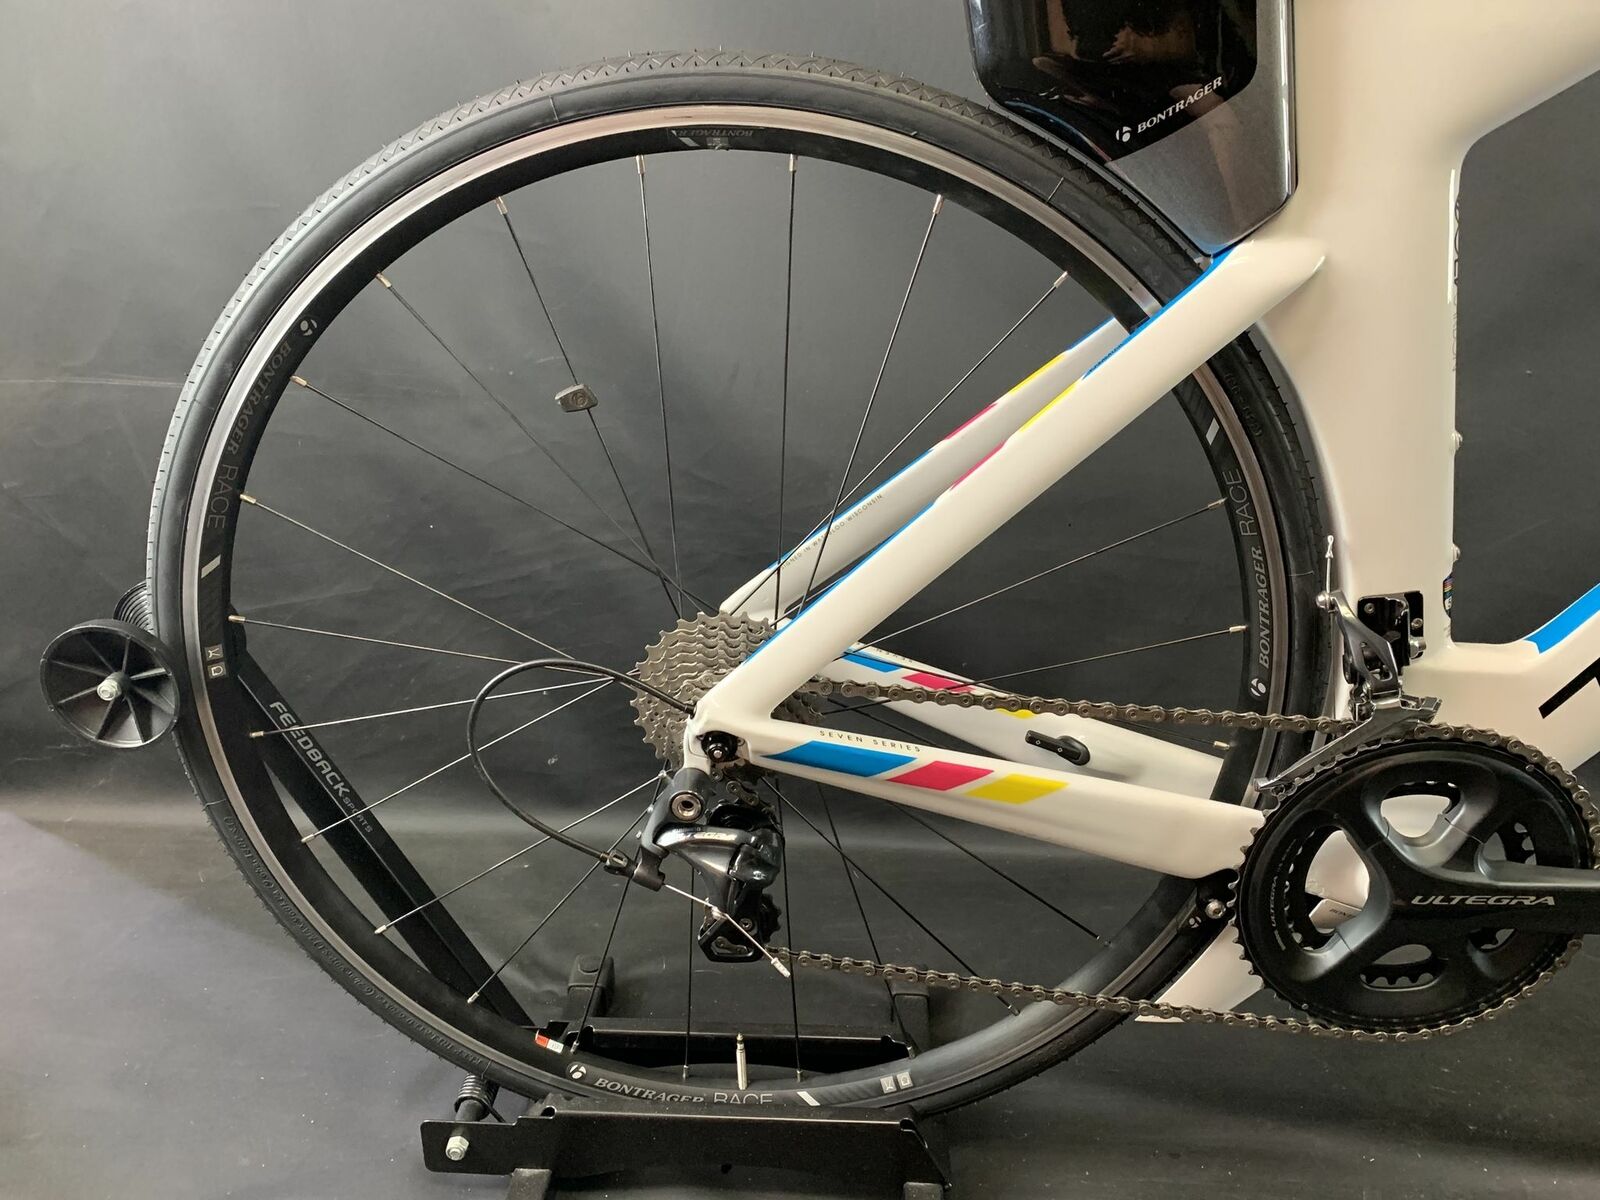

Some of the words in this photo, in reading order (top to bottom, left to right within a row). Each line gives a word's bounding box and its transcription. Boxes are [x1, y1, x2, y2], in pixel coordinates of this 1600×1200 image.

[1137, 76, 1222, 133] BONTRAGER
[227, 339, 292, 455] BONTRAGER
[206, 463, 238, 529] RACE
[847, 494, 883, 521] WISCONSIN
[1223, 468, 1258, 537] RACE
[1252, 546, 1270, 669] BONTRAGER
[269, 701, 350, 797] FEEDBACK
[819, 730, 863, 743] SEVEN
[872, 739, 921, 752] SERIES
[1411, 895, 1556, 906] ULTEGRA
